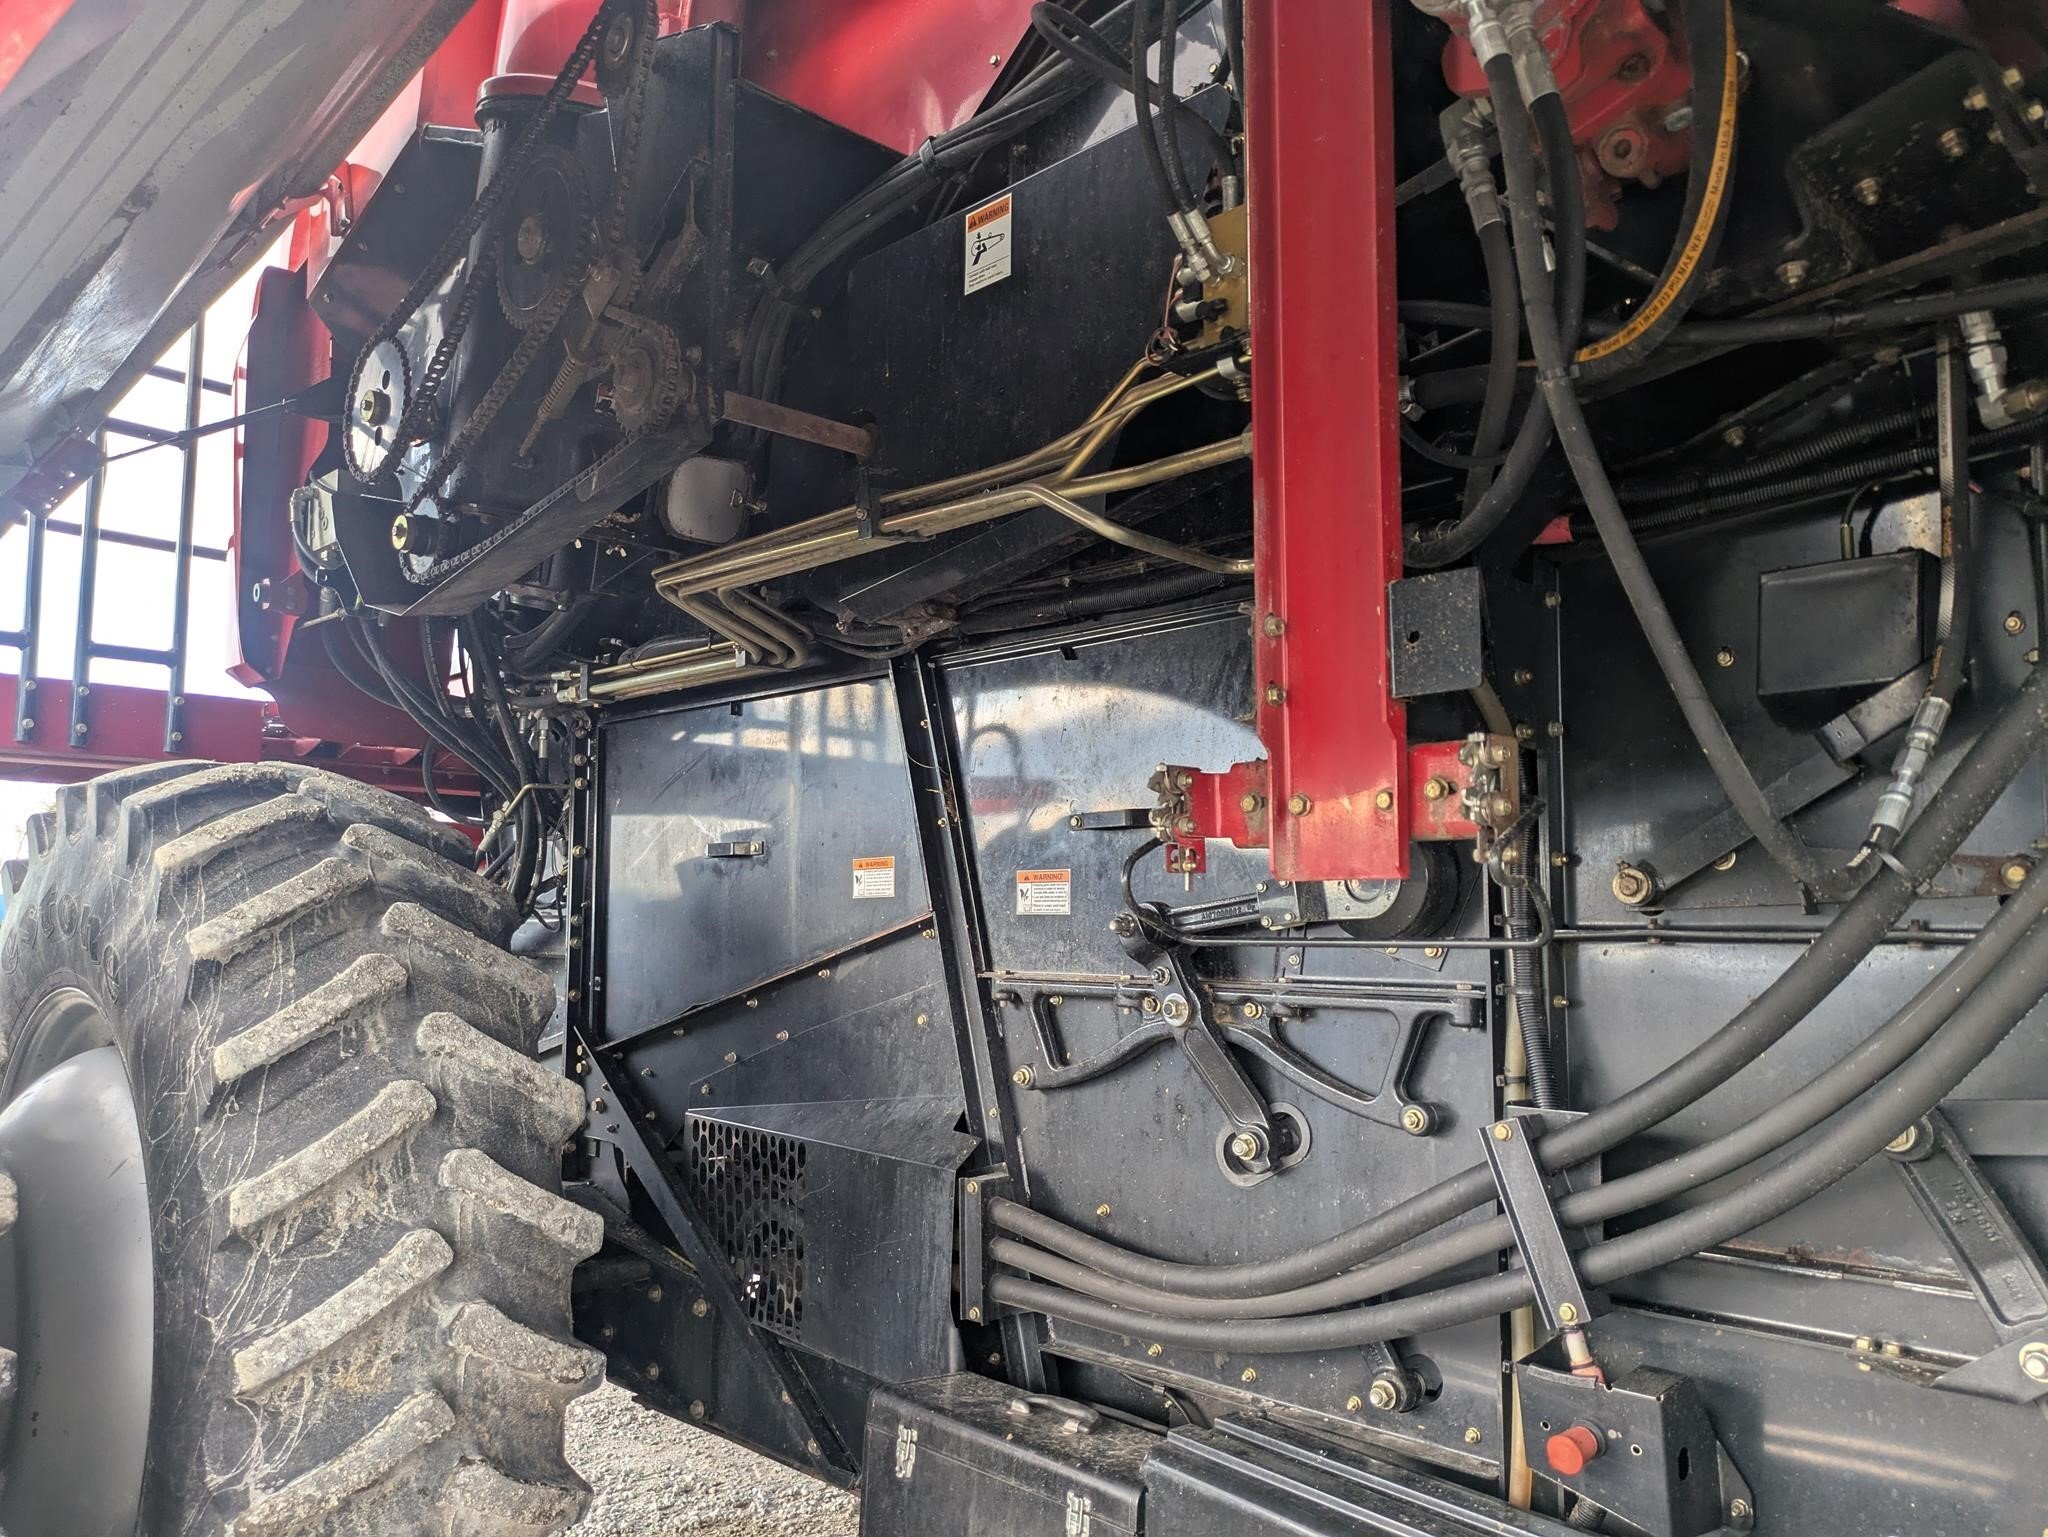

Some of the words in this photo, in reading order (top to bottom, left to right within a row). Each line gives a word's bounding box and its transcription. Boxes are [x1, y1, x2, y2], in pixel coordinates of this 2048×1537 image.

[978, 203, 1009, 223] WARNING
[1641, 304, 1659, 323] INCH
[1666, 274, 1682, 292] PSI
[1676, 253, 1694, 276] MAX
[1709, 165, 1724, 195] Made
[1718, 151, 1727, 162] in
[1032, 873, 1064, 881] WARNING
